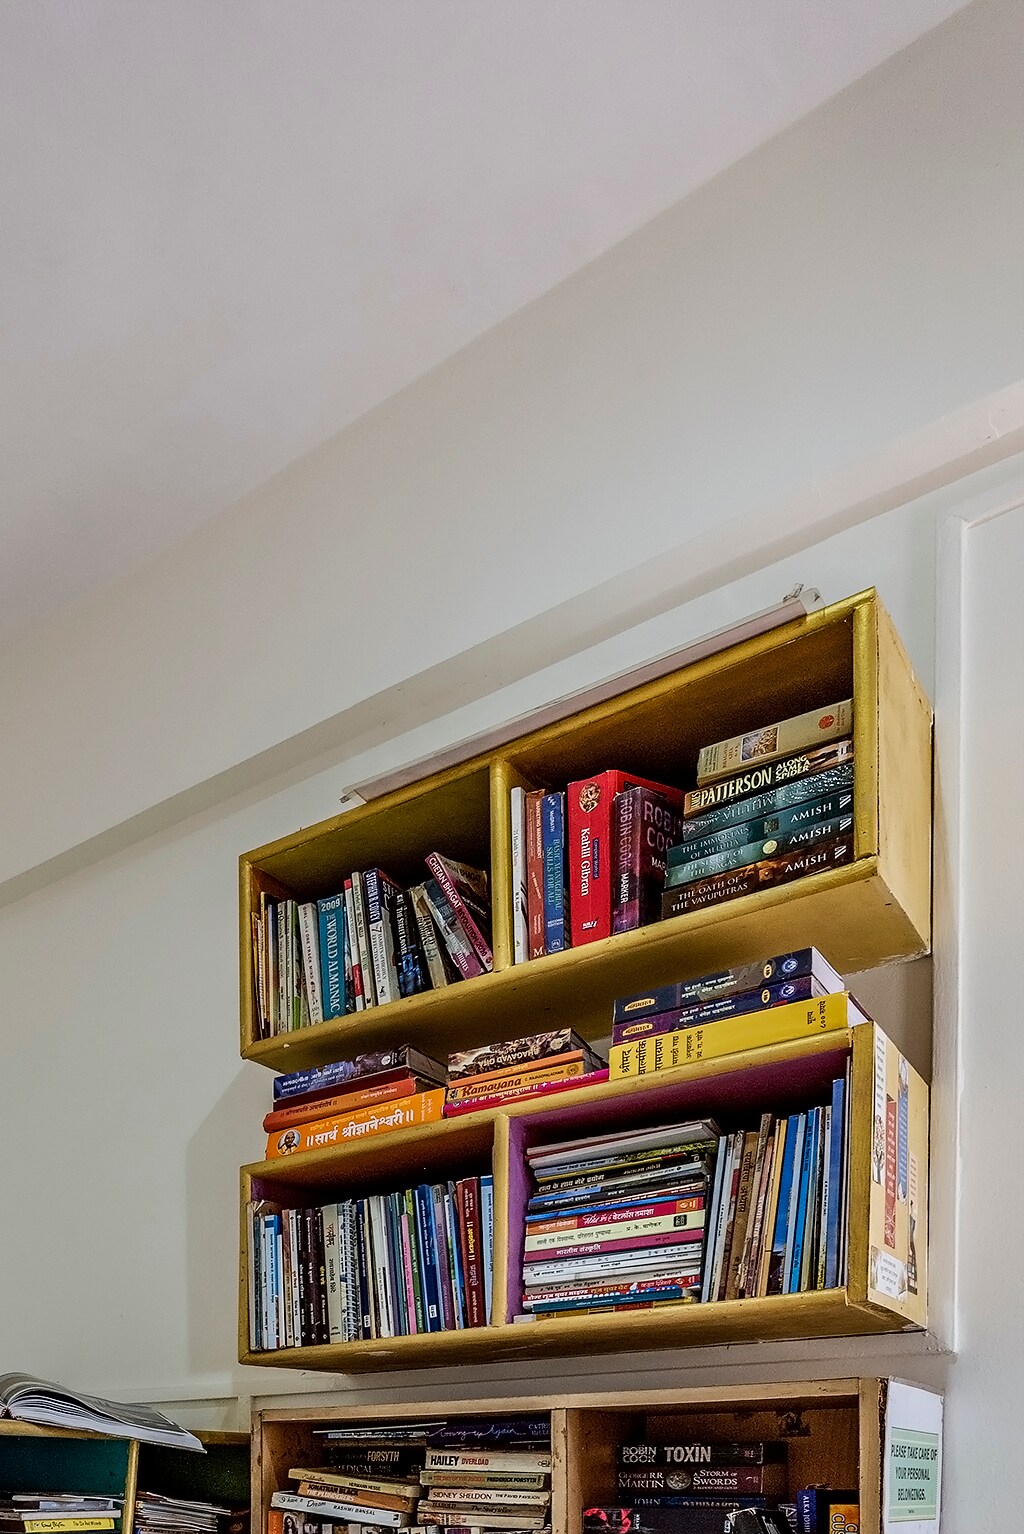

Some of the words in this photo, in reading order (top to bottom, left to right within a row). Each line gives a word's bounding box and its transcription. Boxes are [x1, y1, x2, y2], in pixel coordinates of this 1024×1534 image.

[701, 767, 772, 806] PATTERSON
[790, 803, 832, 823] AMISH
[700, 827, 749, 849] IMMORTALS
[789, 825, 832, 845] AMISH
[785, 853, 827, 873] AMISH
[428, 857, 445, 885] CHETAN
[442, 882, 462, 908] BHAGAT
[620, 871, 629, 904] MARKER
[678, 890, 696, 901] THE
[698, 881, 726, 897] OATH
[727, 877, 740, 887] OF
[671, 900, 690, 912] THE
[691, 882, 749, 906] VAYUPUTRAS
[321, 899, 341, 913] 2009
[326, 919, 338, 959] WORLD
[328, 960, 341, 1013] ALMANAC
[478, 1057, 496, 1067] GITA
[496, 1048, 539, 1063] BHAGAVAD
[462, 1077, 522, 1098] Ramayana
[556, 1246, 578, 1256] भारतीय
[367, 1450, 400, 1462] FORSYTH
[622, 1446, 657, 1456] ROBIN
[622, 1454, 657, 1463] COOK
[664, 1446, 712, 1463] TOXIN
[890, 1444, 907, 1458] PLEASE
[907, 1446, 919, 1459] TAKE
[918, 1447, 930, 1461] CARE
[930, 1448, 938, 1461] OF
[430, 1455, 460, 1466] HAILEY
[461, 1457, 489, 1466] OVERLOAD
[692, 1477, 738, 1486] SWORDS
[699, 1469, 730, 1478] STORM
[895, 1466, 907, 1480] YOUR
[907, 1466, 930, 1481] PERSONAL
[307, 1484, 338, 1494] JONATHAN
[618, 1478, 665, 1489] MARTIN
[355, 1508, 376, 1516] BANSAL
